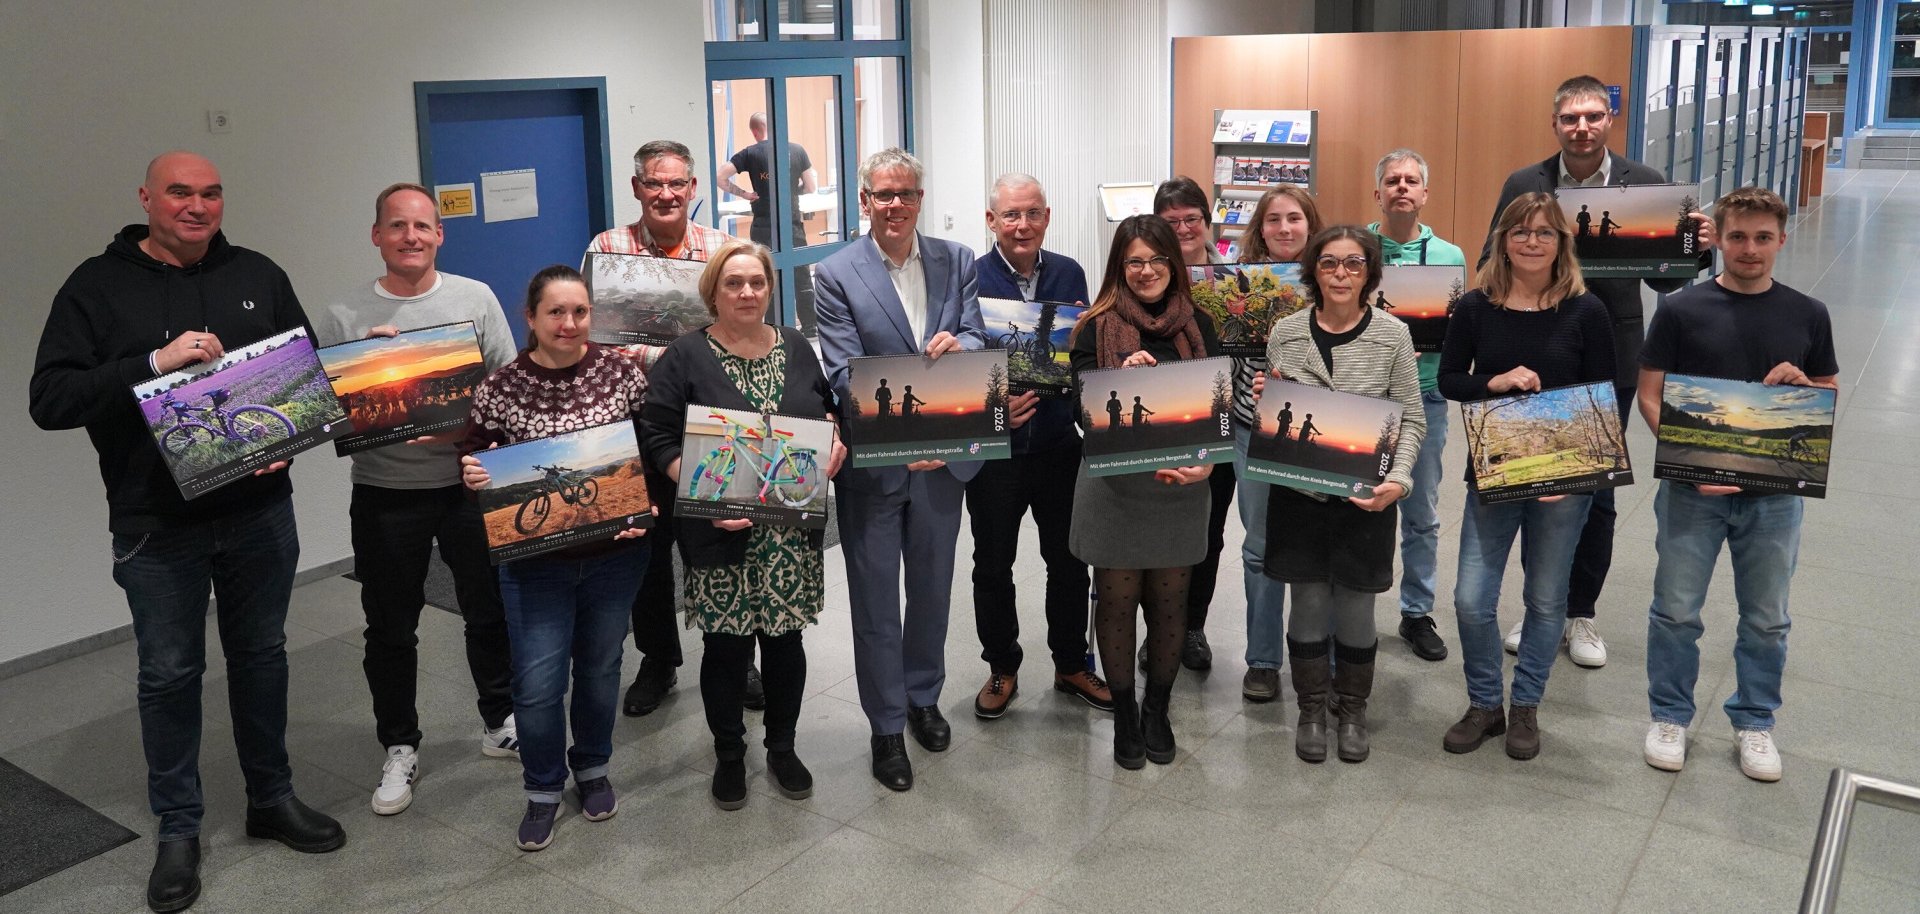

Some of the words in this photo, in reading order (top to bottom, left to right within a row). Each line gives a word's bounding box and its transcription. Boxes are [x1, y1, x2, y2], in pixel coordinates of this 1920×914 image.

[1683, 232, 1693, 254] 2026
[994, 406, 1004, 432] 2026
[1219, 412, 1230, 437] 2026
[936, 447, 963, 455] Bergstraße
[1129, 458, 1143, 466] durch
[1166, 453, 1192, 462] Bergstraße
[1378, 452, 1390, 477] 2026
[1268, 469, 1286, 478] Fahrrad
[1286, 472, 1301, 480] durch
[1310, 476, 1322, 484] Kreis
[1322, 478, 1348, 489] Bergstraße
